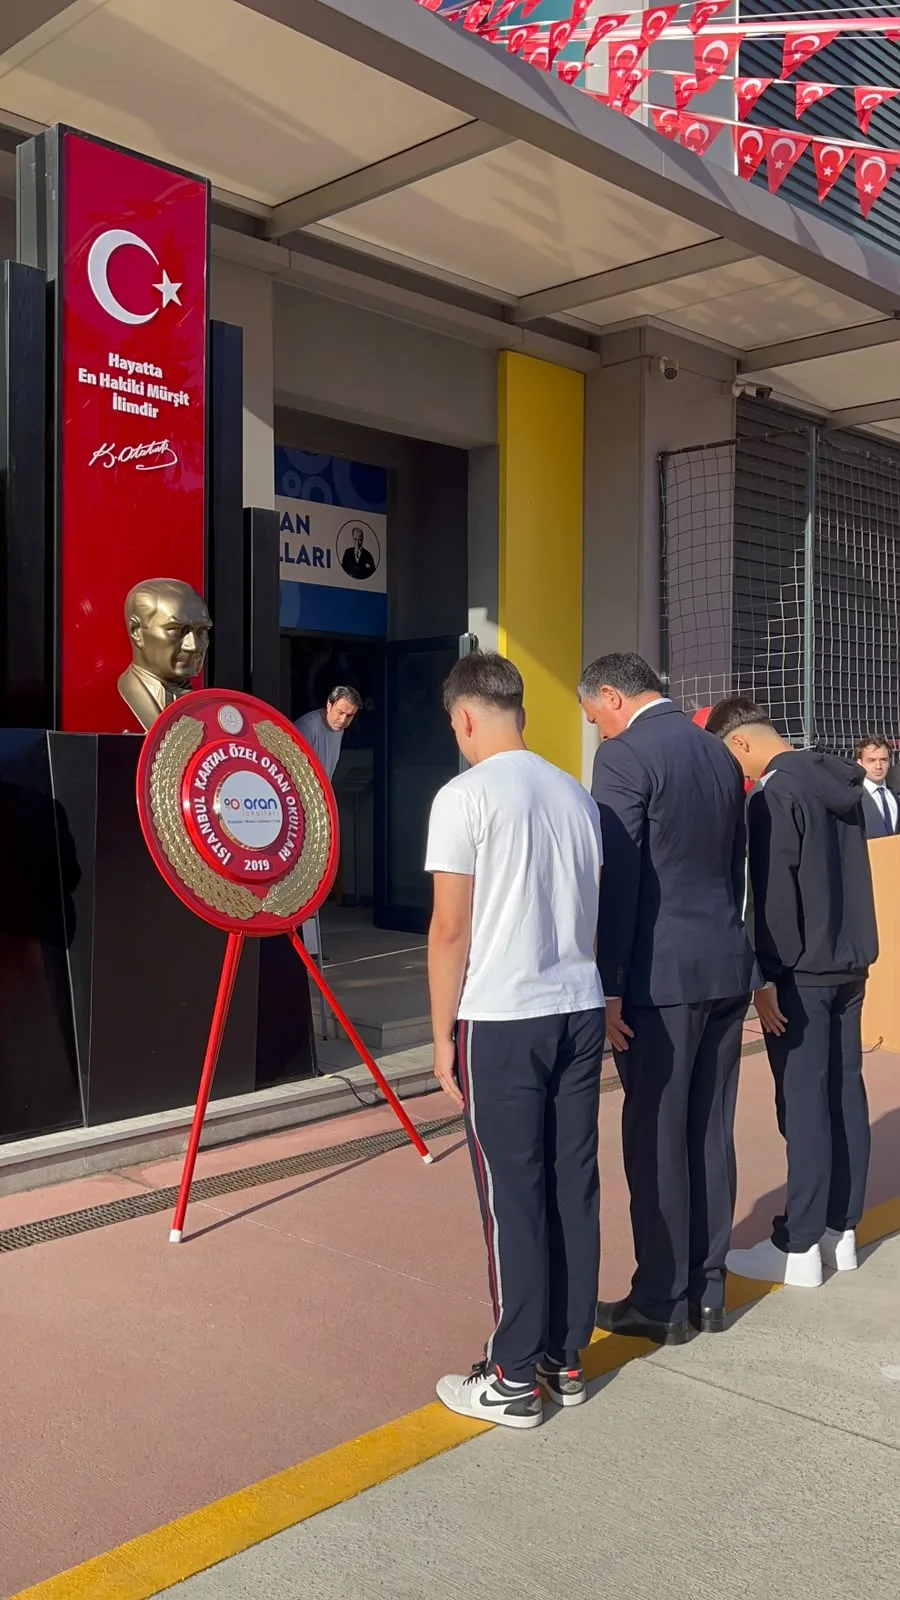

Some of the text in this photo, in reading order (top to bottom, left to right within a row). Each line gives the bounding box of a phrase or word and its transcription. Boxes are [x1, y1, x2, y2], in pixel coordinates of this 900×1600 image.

[108, 352, 163, 378] Hayatta
[78, 367, 190, 407] En Hakiki Mürşit
[112, 392, 159, 418] İlimdir
[280, 542, 331, 569] LARI
[194, 747, 228, 791] KARTAL
[229, 743, 259, 764] ÖZEL
[260, 756, 291, 793] ORAN
[278, 795, 299, 862] OKULLARI
[244, 798, 278, 810] oran
[244, 859, 270, 871] 2019
